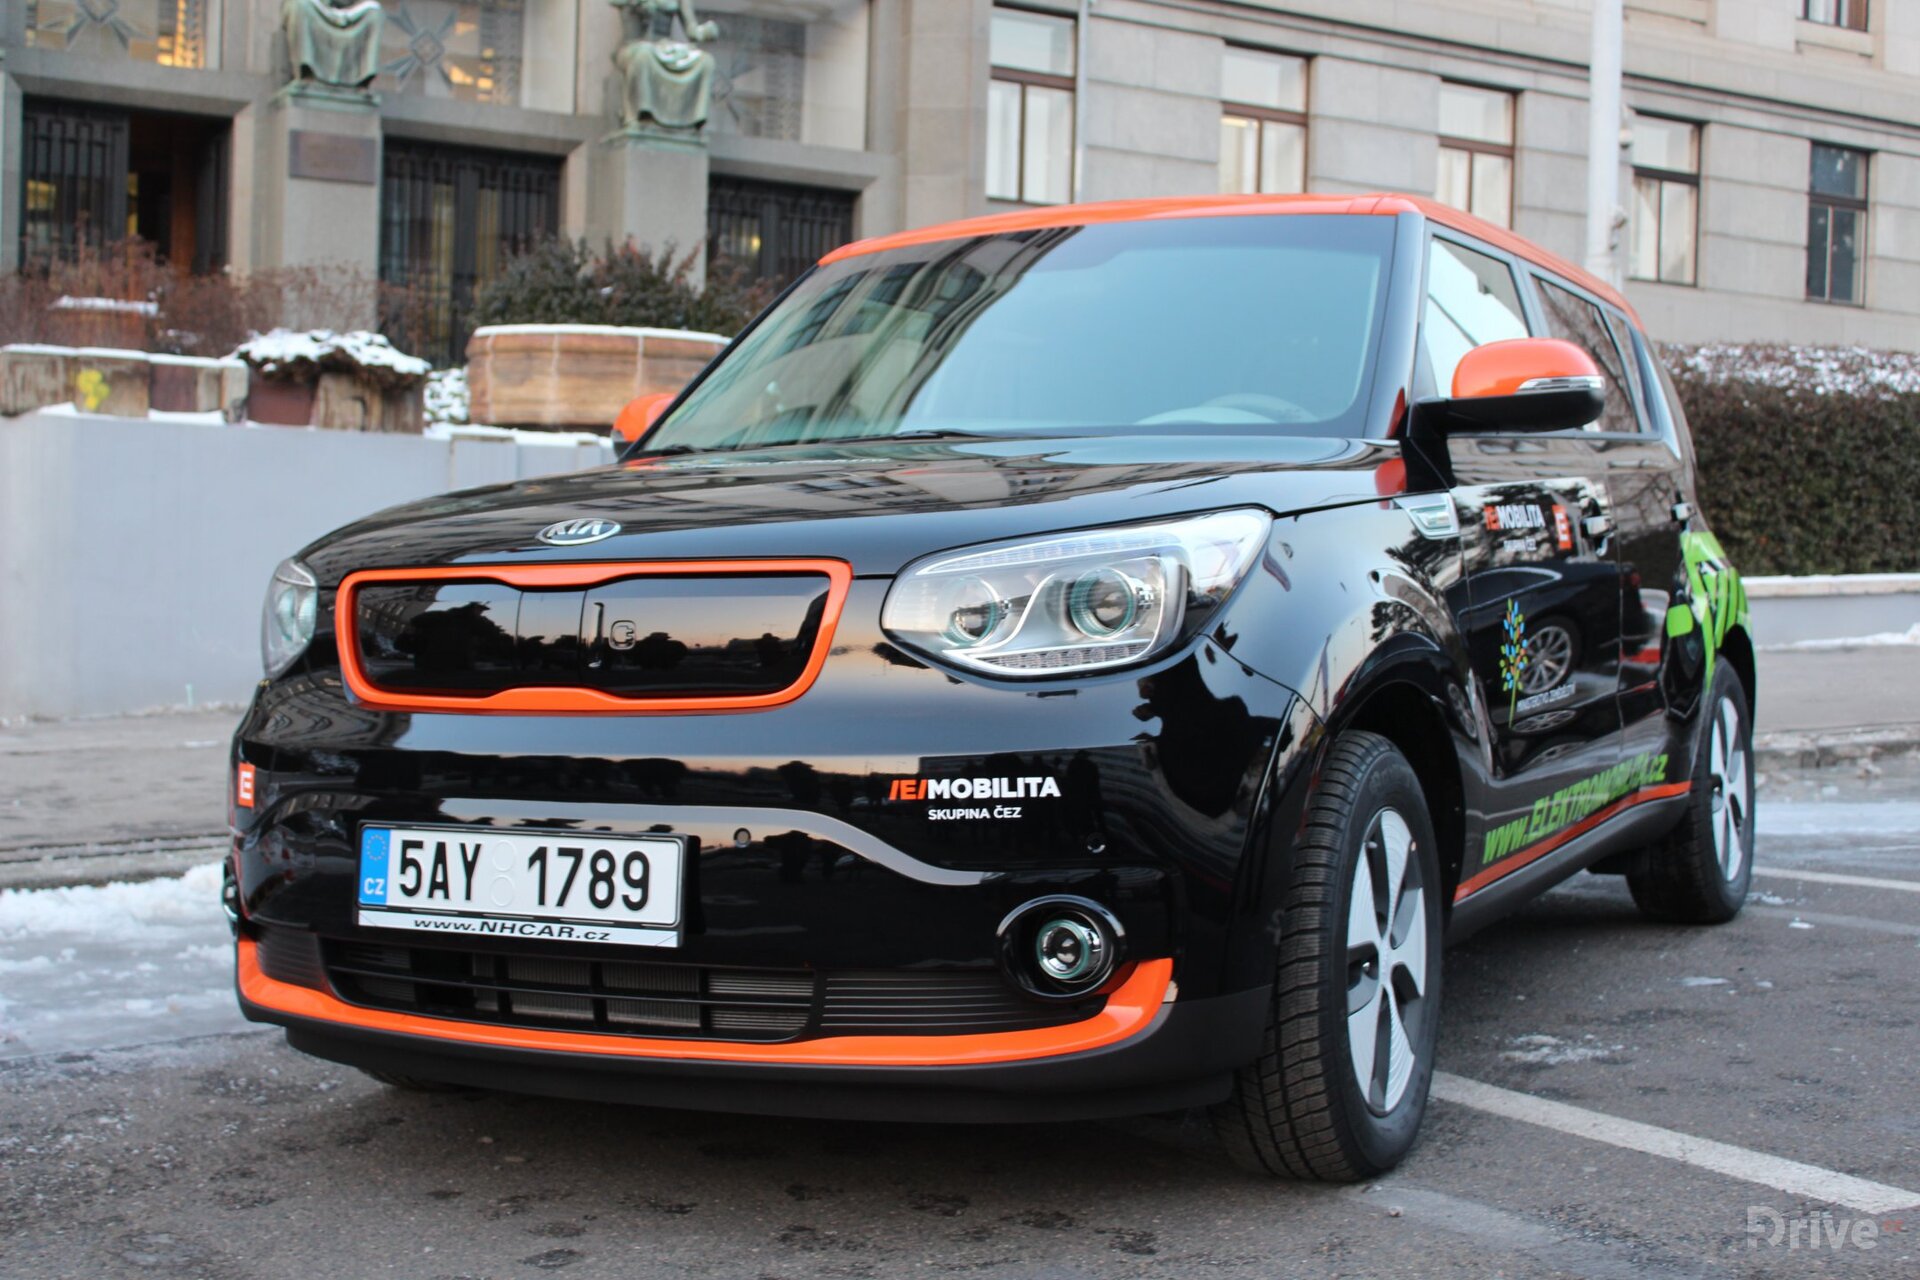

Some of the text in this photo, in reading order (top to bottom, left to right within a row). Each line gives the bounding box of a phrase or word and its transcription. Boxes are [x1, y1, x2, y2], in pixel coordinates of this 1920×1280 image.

[544, 518, 606, 539] KIA
[928, 804, 1022, 821] SKUPINA ČEZ
[398, 839, 651, 911] 5AY 1789
[364, 877, 385, 896] CZ
[413, 918, 612, 942] www.NHCAR.cz
